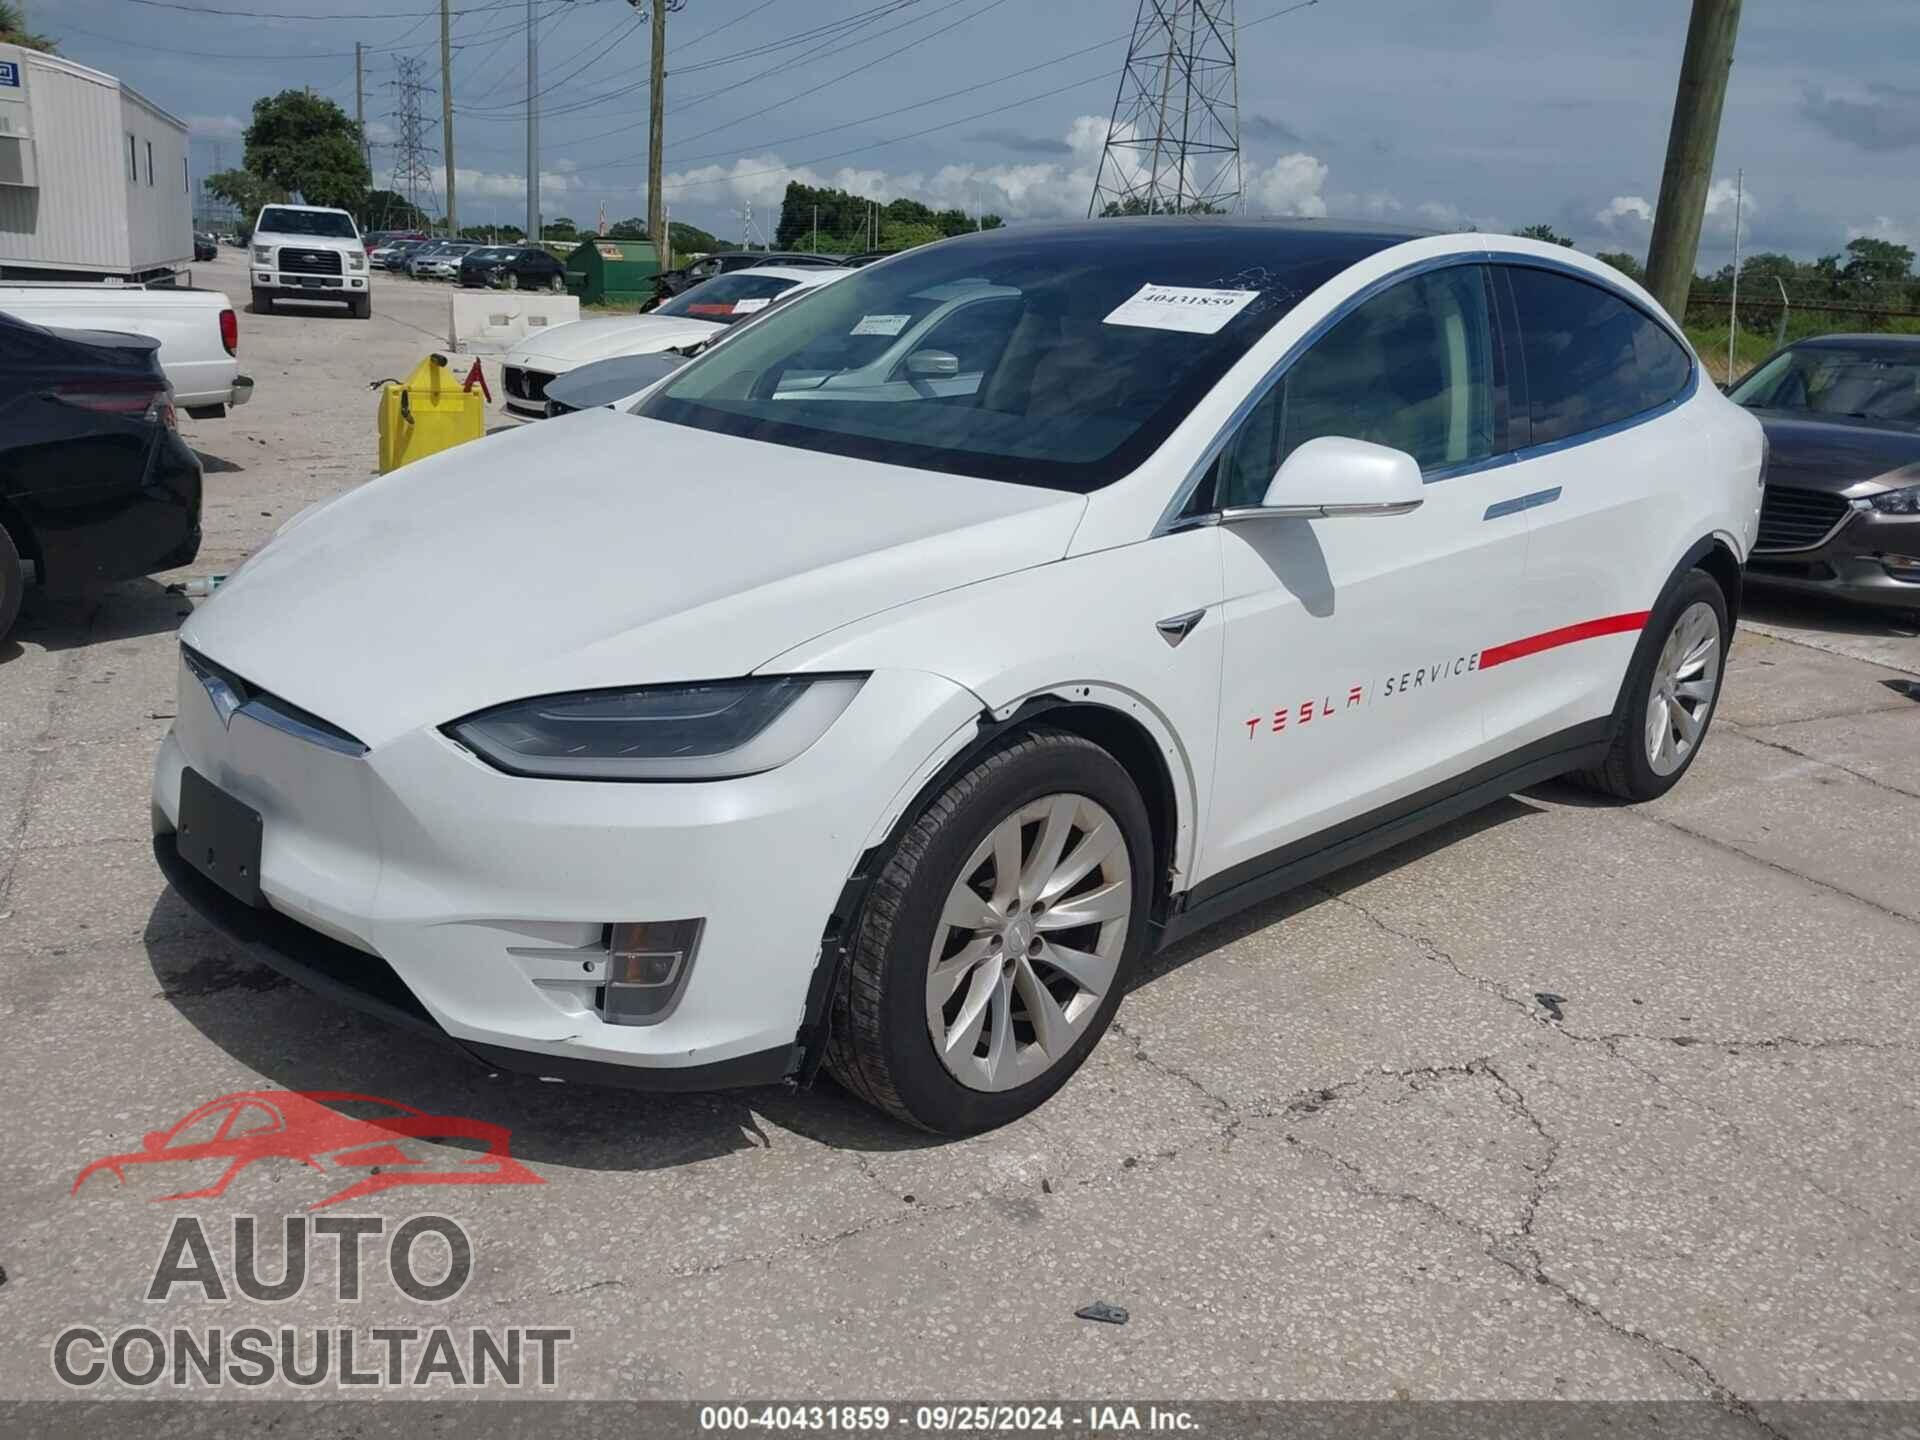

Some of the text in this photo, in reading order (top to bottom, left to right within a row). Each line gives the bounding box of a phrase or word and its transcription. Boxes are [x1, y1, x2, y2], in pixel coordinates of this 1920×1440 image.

[1143, 294, 1235, 306] 40431859
[1246, 652, 1478, 740] TESLA SERVICE
